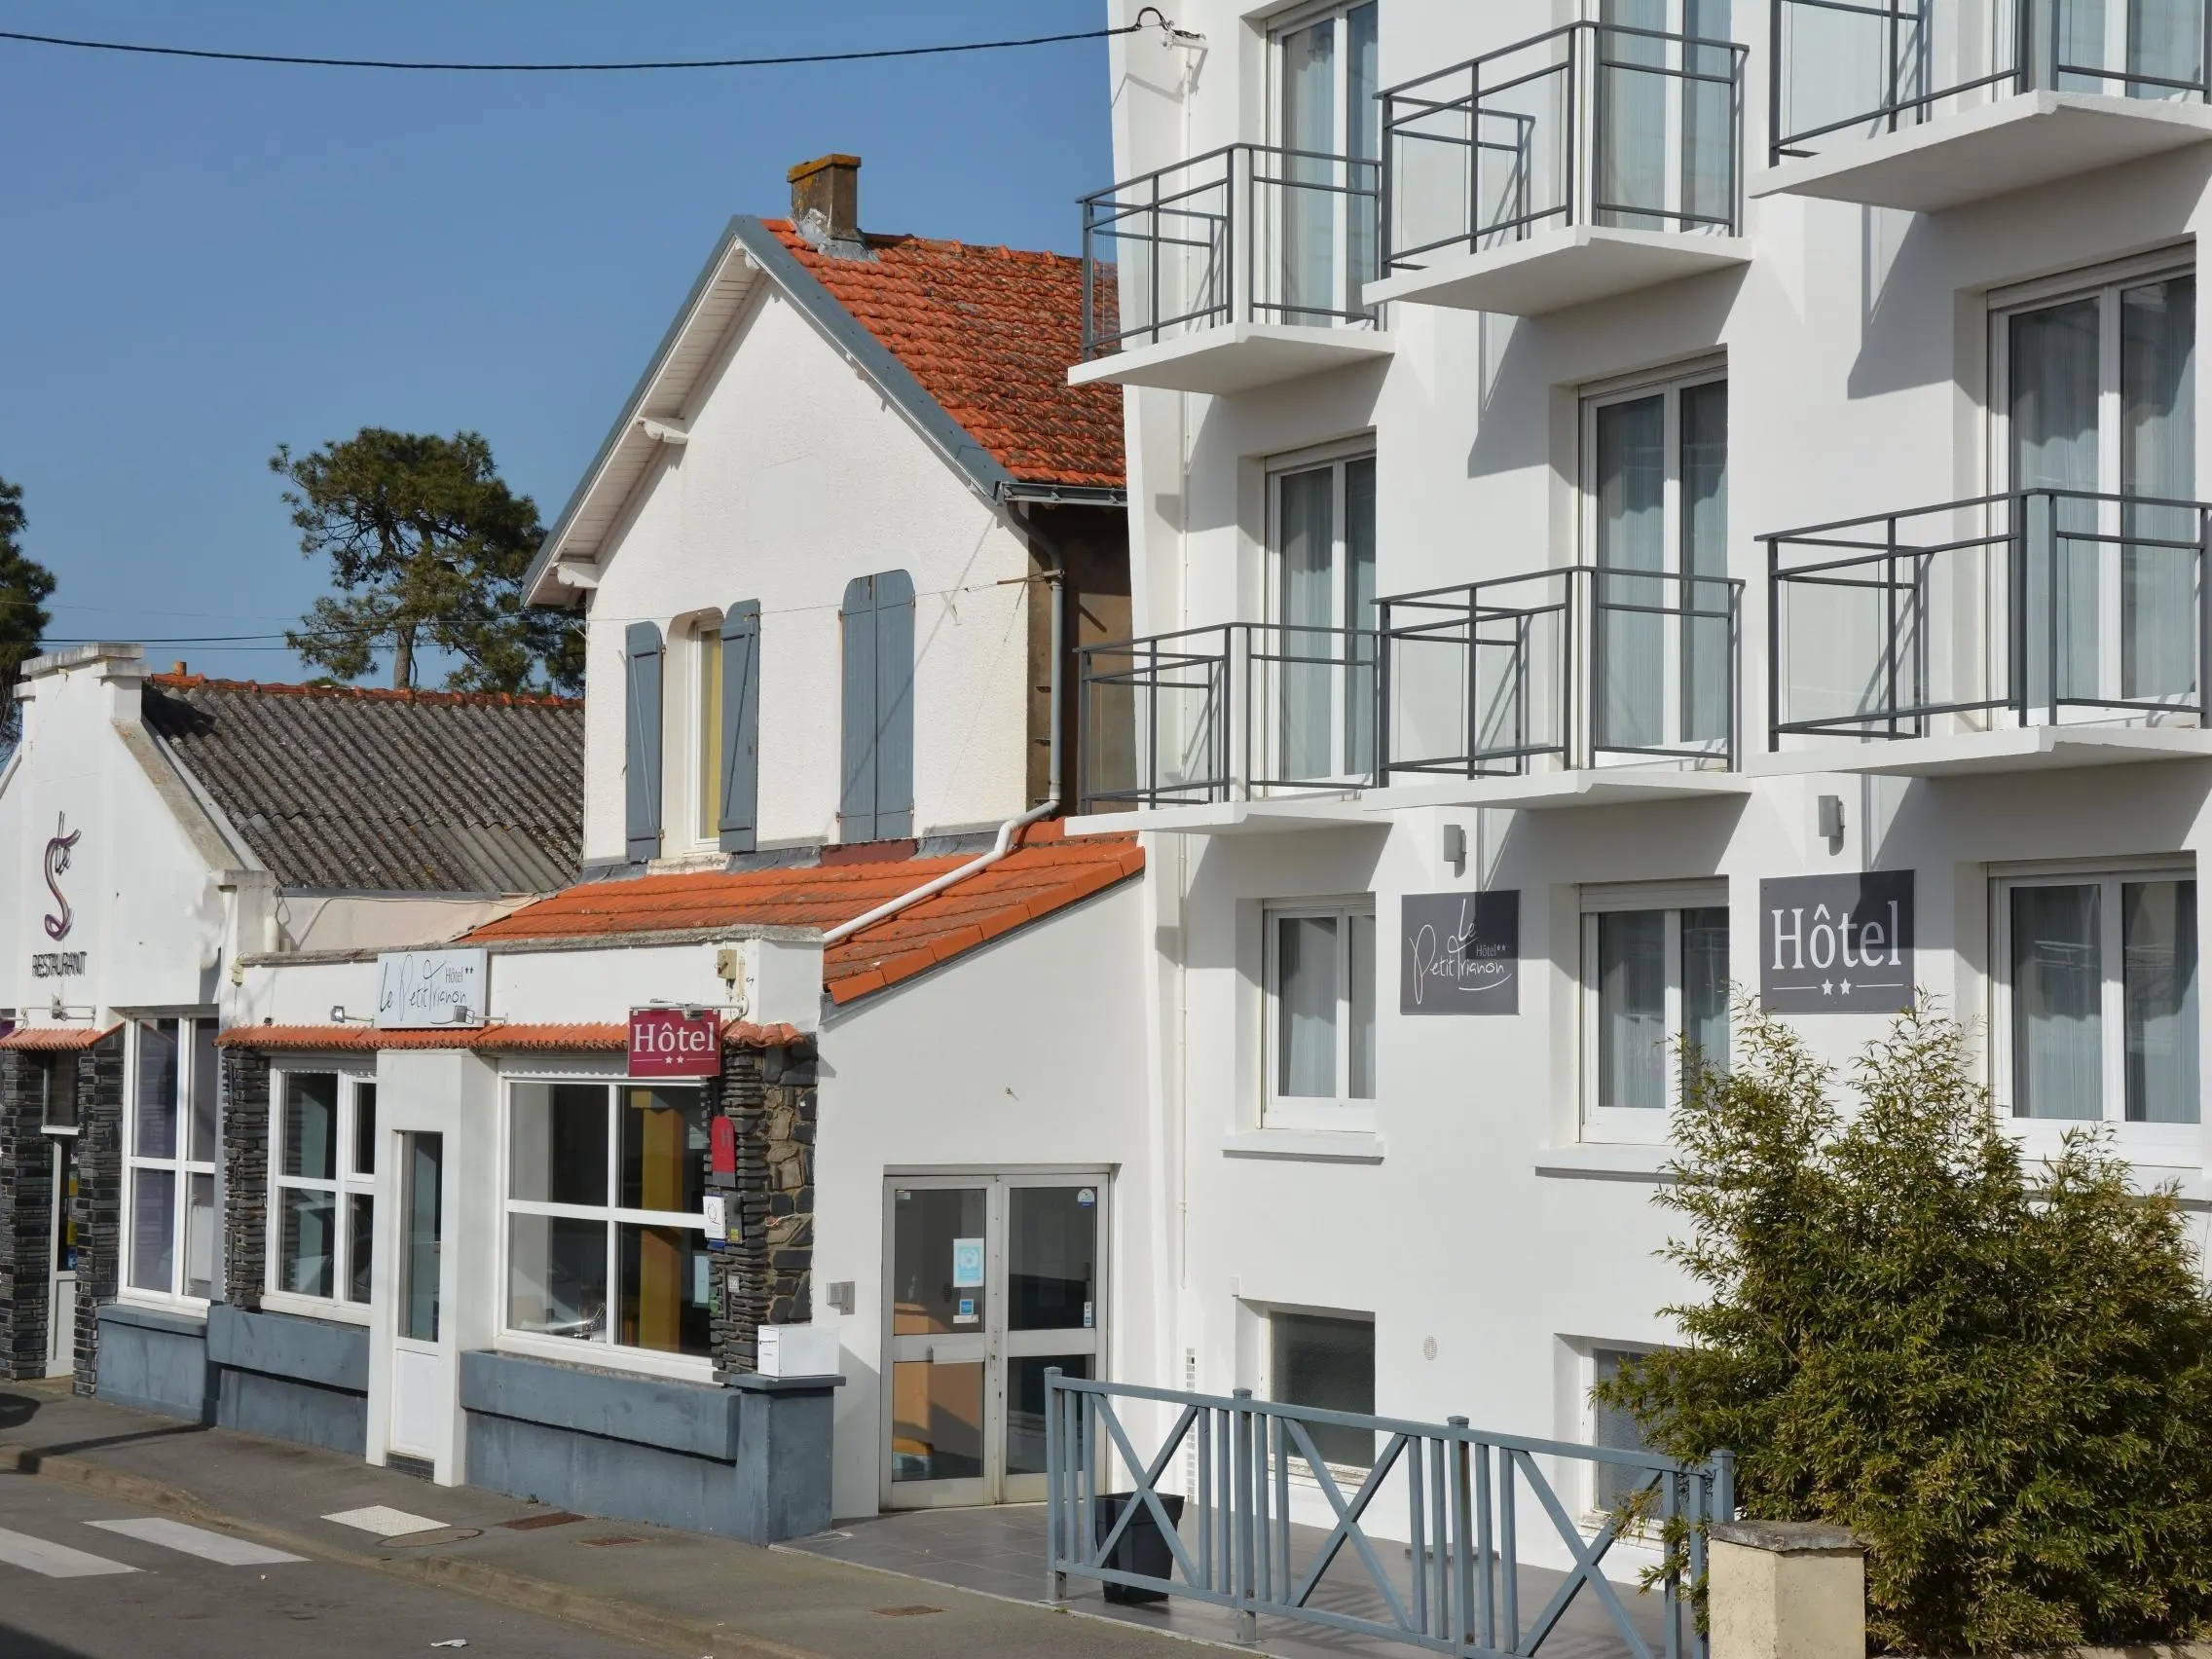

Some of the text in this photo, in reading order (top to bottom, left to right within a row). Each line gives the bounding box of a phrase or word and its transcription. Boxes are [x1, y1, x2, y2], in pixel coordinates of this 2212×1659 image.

[1458, 898, 1476, 941] Le
[1476, 943, 1496, 957] Hôtel
[1771, 900, 1901, 970] Hôtel
[31, 951, 88, 977] RESTAURANT
[445, 967, 464, 983] Hôtel
[378, 961, 393, 1013] Le
[633, 1022, 716, 1052] Hôtel
